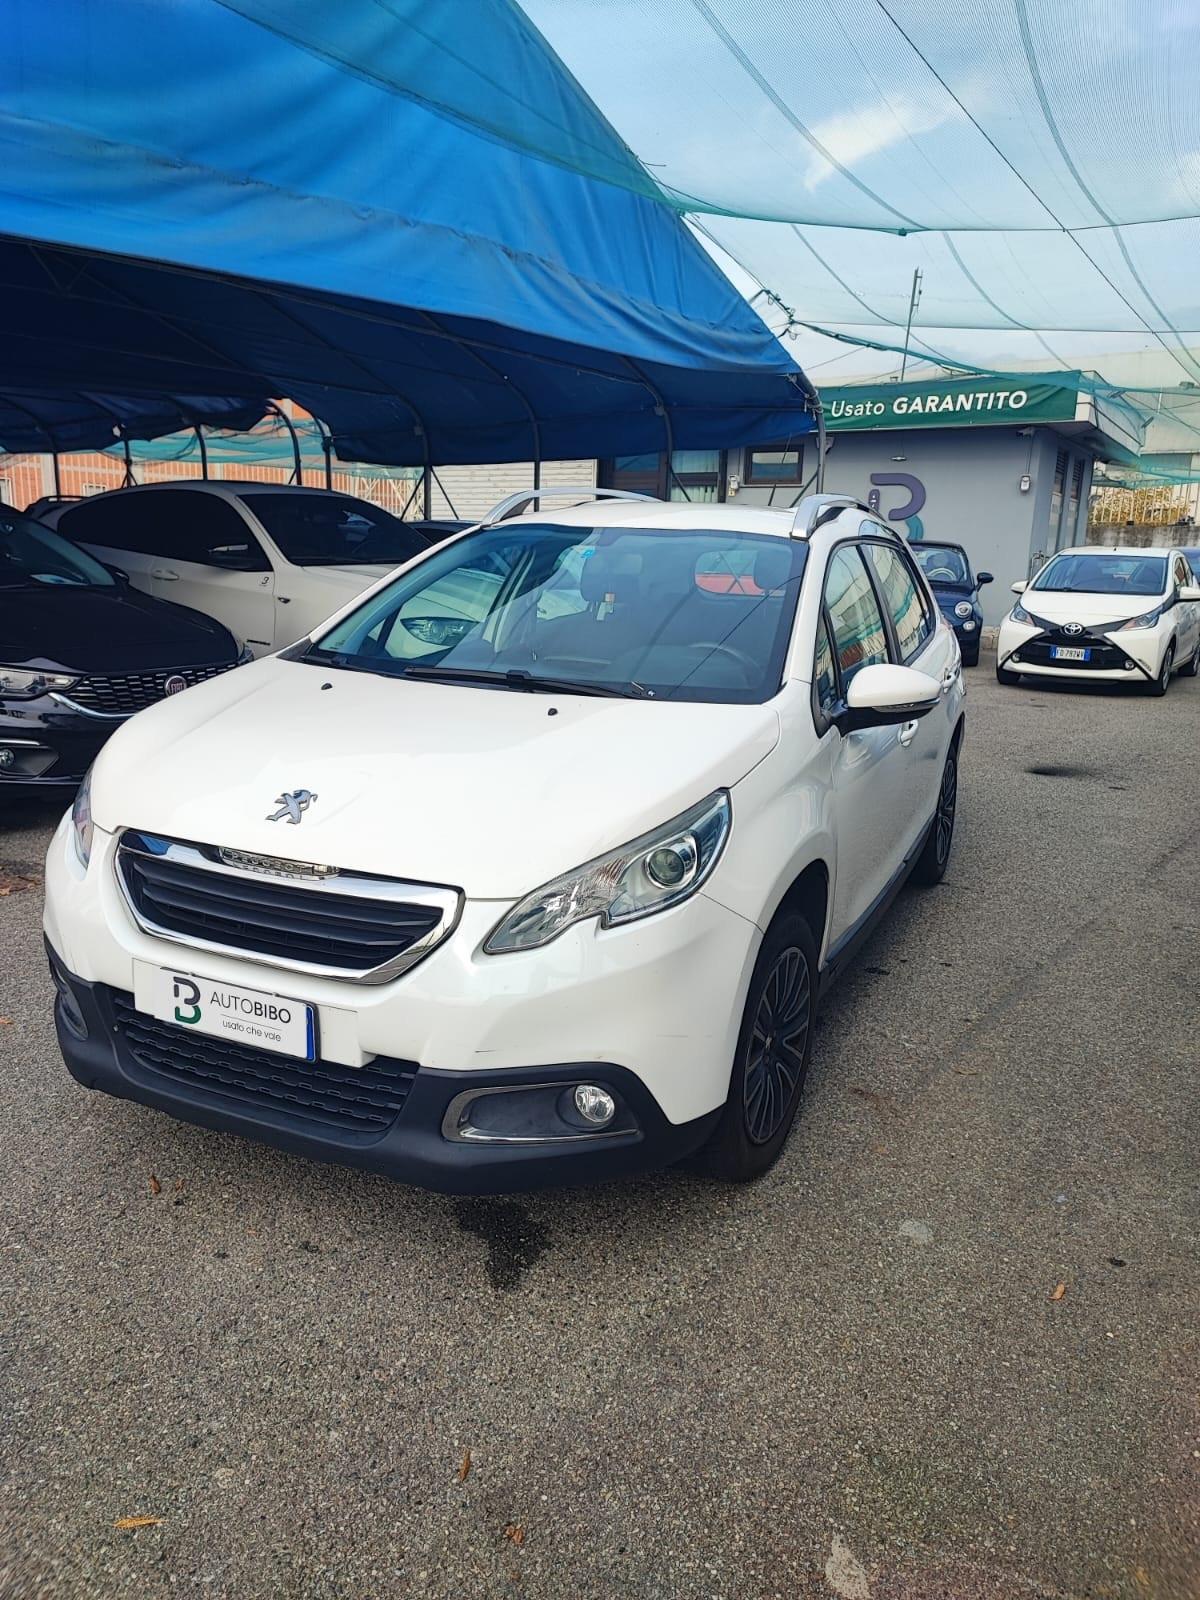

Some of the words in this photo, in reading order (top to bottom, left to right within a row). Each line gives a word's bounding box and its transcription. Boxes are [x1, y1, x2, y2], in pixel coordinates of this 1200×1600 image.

[831, 400, 885, 417] Usato
[892, 390, 1028, 415] GARANTITO
[231, 850, 306, 874] PEUGEOT
[210, 991, 291, 1024] AUTOBIBO
[222, 1019, 245, 1032] usato
[246, 1024, 262, 1037] che
[263, 1030, 282, 1042] vale
